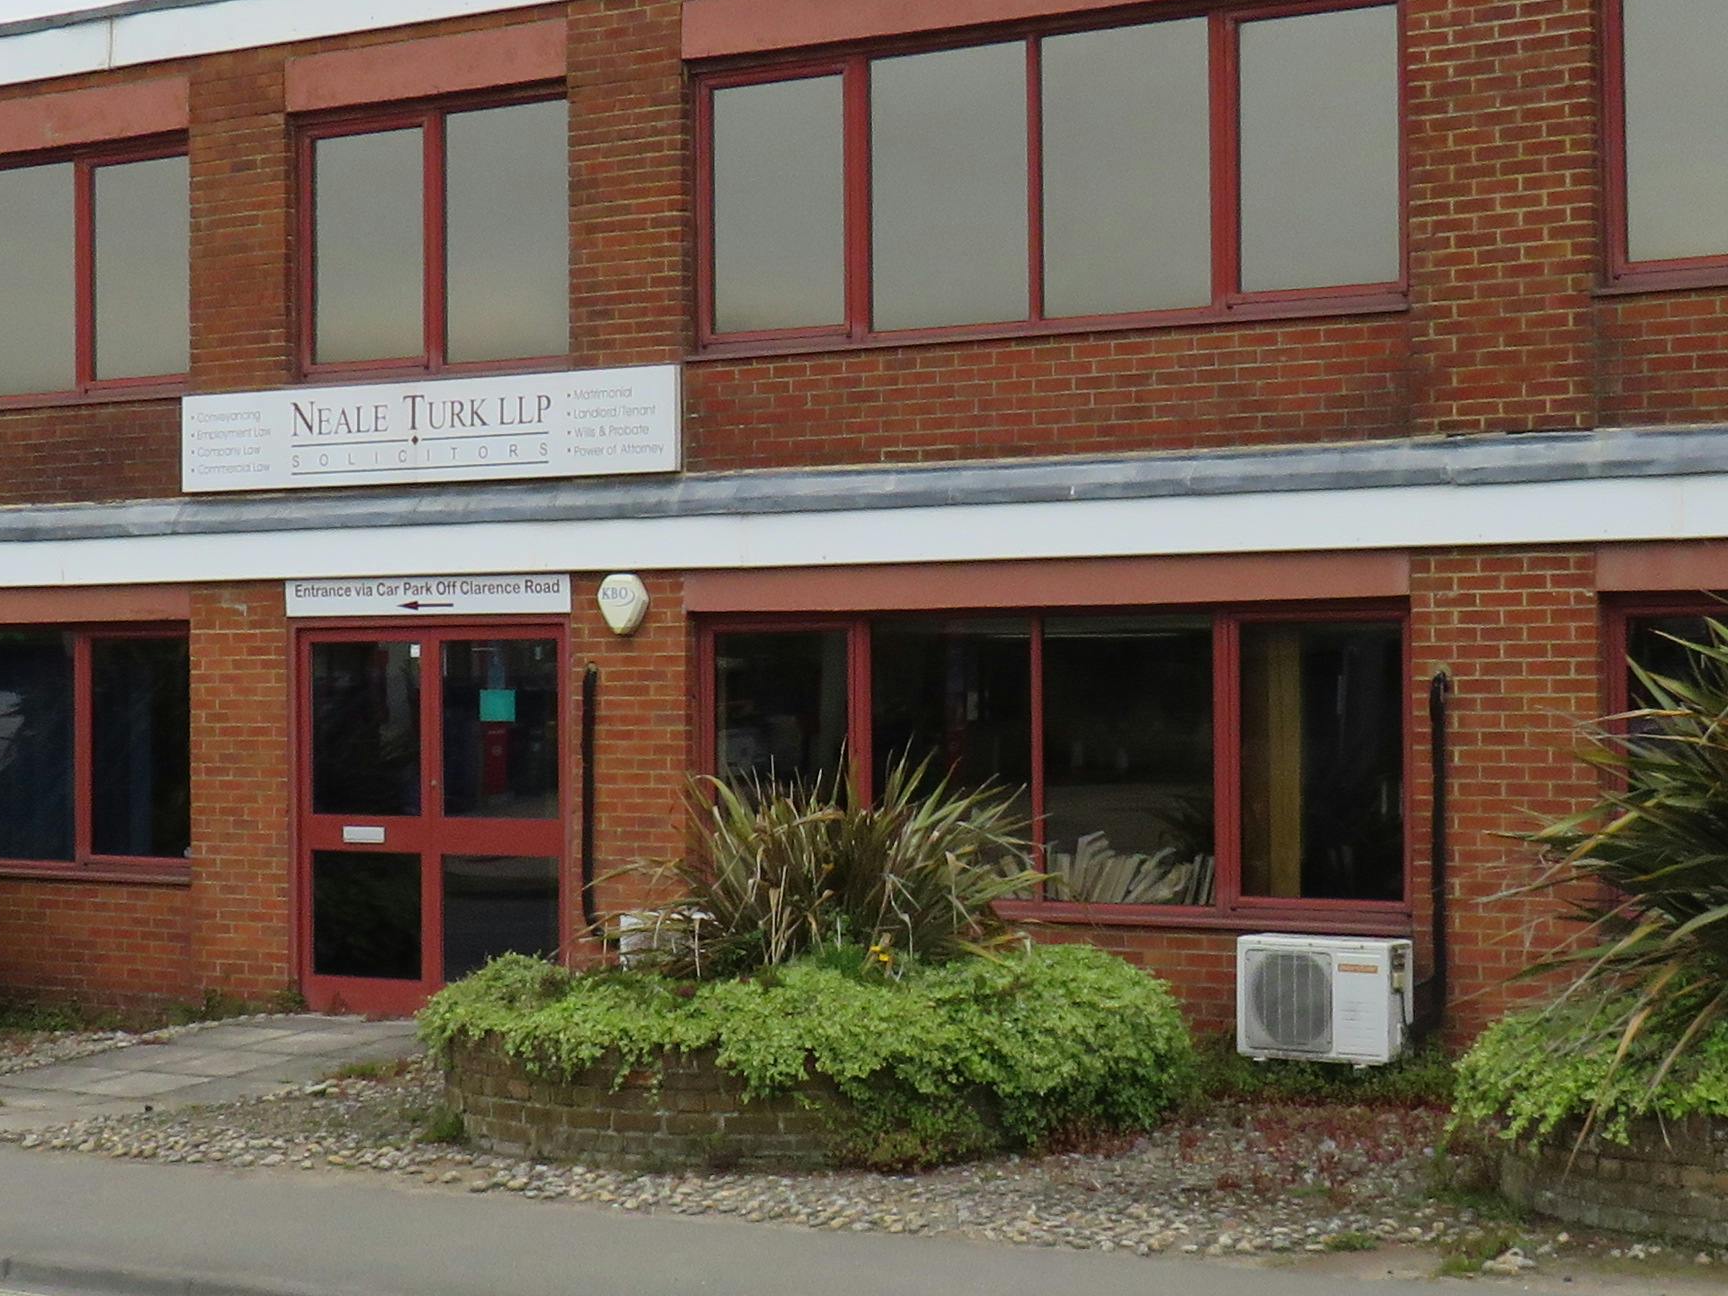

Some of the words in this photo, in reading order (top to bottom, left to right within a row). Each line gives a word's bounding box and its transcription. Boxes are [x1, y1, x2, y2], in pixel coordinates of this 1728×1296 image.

[574, 386, 632, 400] Matrimonial
[291, 401, 388, 436] NEALE
[403, 394, 489, 430] TURK
[497, 394, 551, 425] LLP
[574, 404, 656, 419] Landlord/Tenant
[197, 429, 253, 441] Employment
[255, 427, 271, 438] Law
[574, 426, 596, 438] Wills
[598, 425, 607, 437] &
[608, 423, 650, 437] Probate
[197, 447, 241, 459] Company
[243, 446, 261, 456] Law
[292, 442, 549, 468] SOLICITORS
[574, 445, 604, 458] Power
[606, 444, 617, 456] of
[620, 442, 664, 456] Attorney
[197, 464, 251, 475] Commercial
[253, 463, 271, 473] Law
[295, 583, 352, 598] Entrance
[355, 583, 373, 597] via
[376, 582, 400, 596] Car
[403, 581, 433, 596] Park
[437, 580, 457, 595] Off
[460, 580, 521, 595] Clarence
[524, 579, 560, 594] Road
[602, 586, 628, 600] KBO
